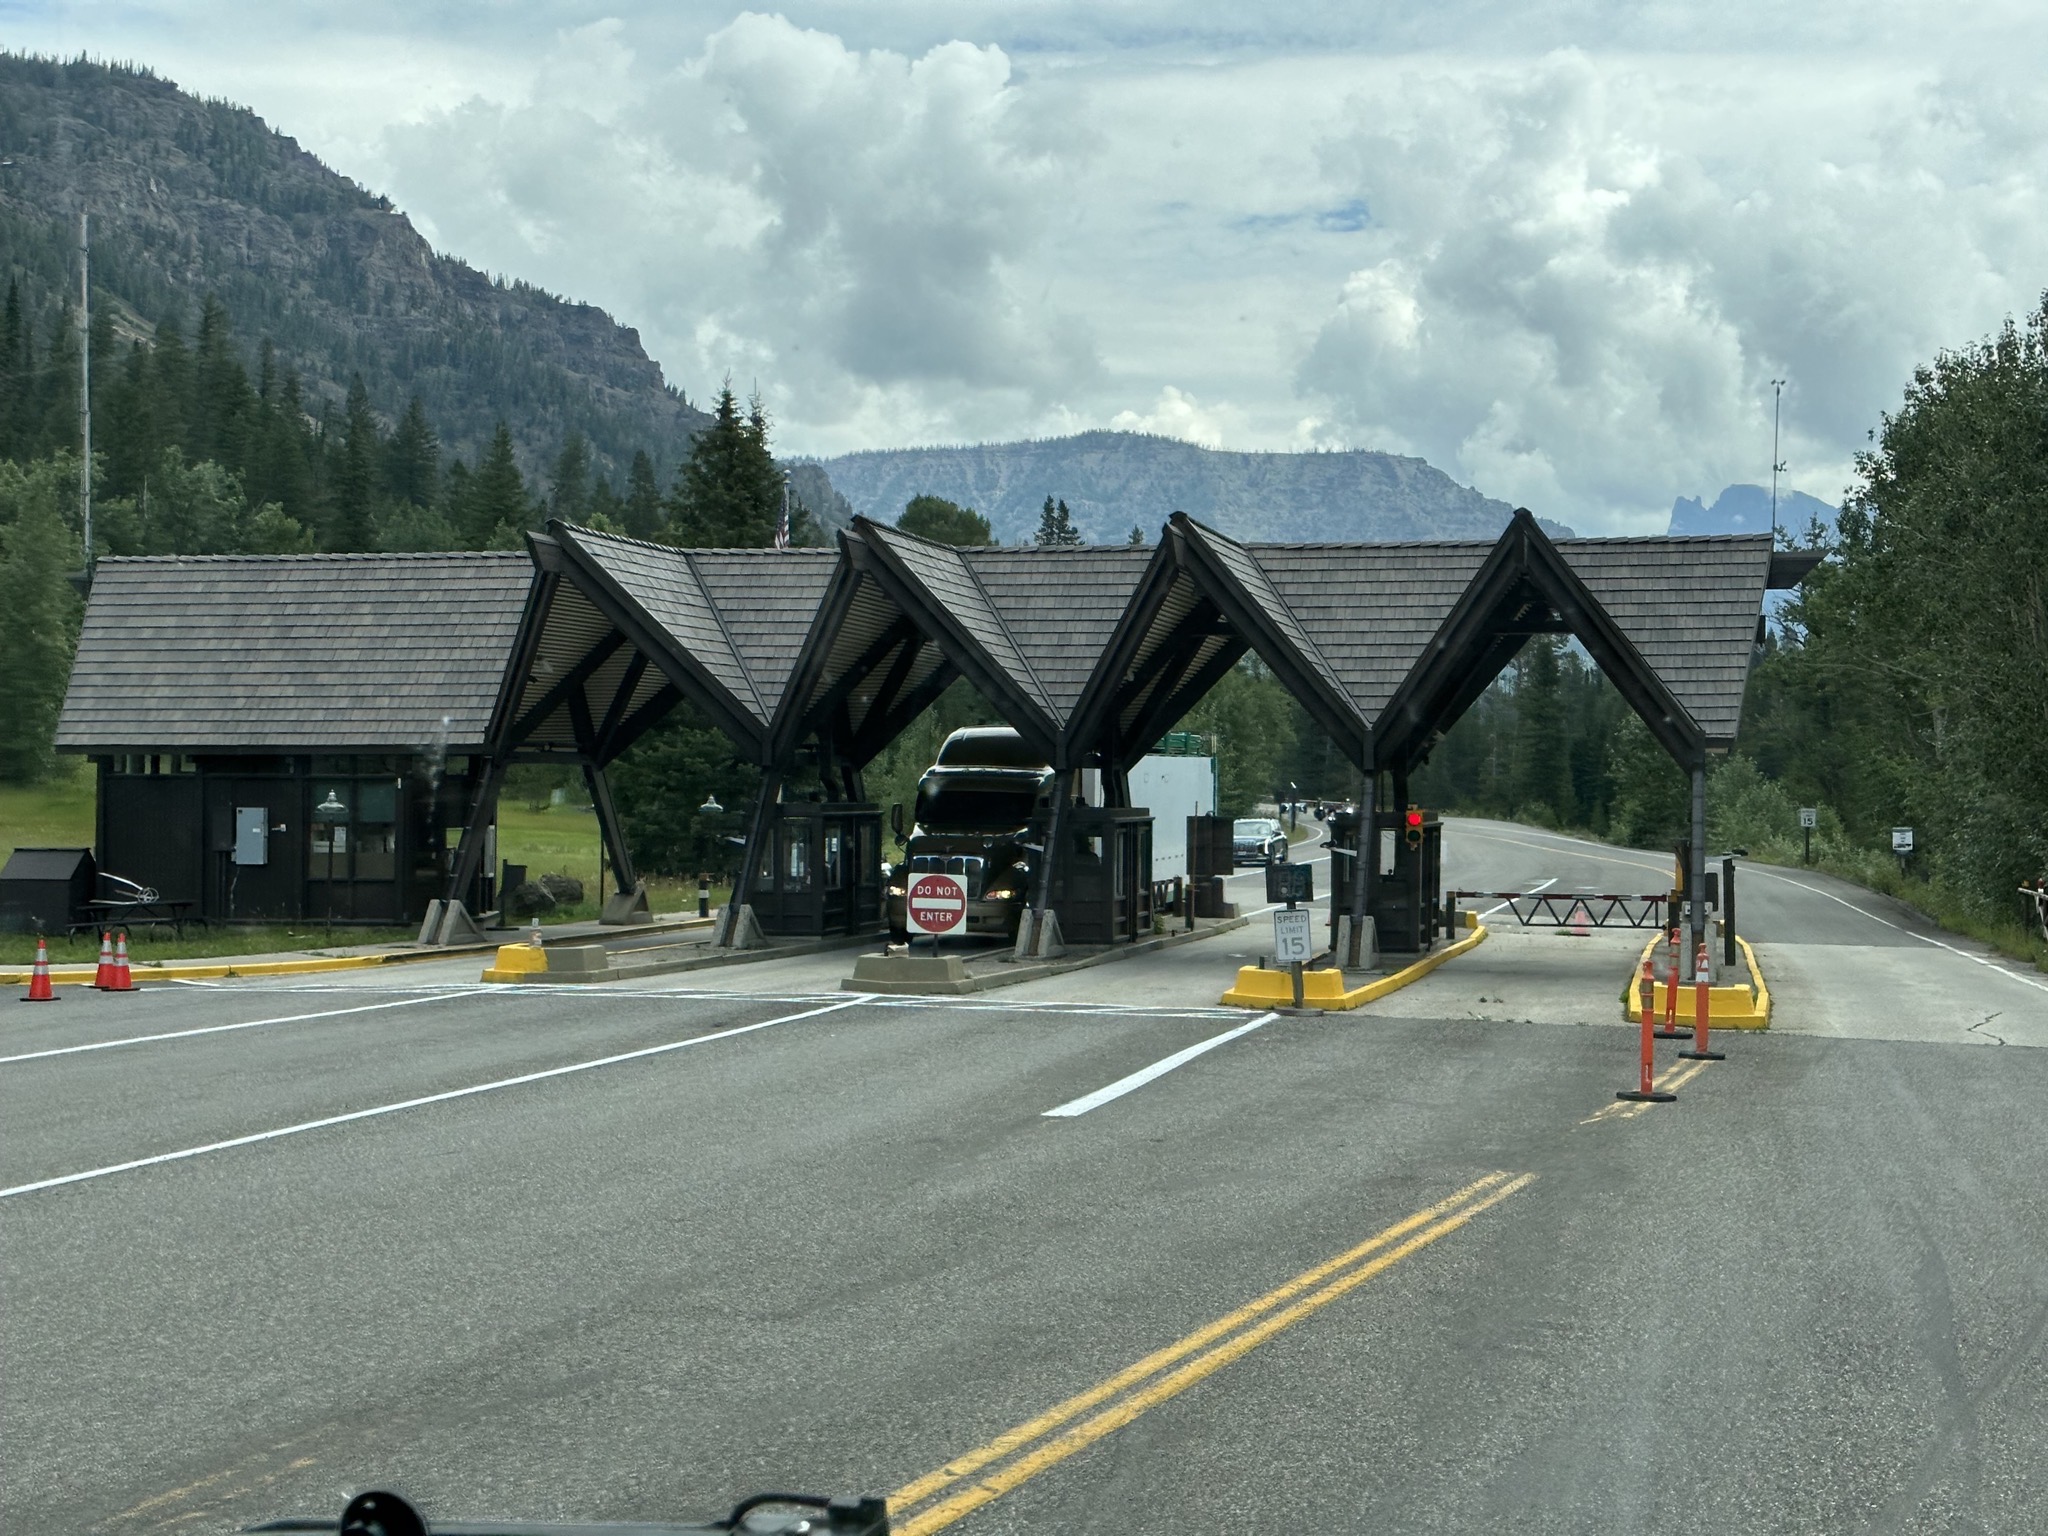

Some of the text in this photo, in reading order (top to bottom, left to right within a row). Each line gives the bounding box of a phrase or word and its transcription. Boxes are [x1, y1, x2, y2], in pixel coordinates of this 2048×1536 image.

[1803, 817, 1813, 825] 15
[917, 885, 957, 896] DO NOT
[920, 911, 952, 921] ENTER
[1277, 914, 1306, 924] SPEED
[1281, 925, 1303, 934] LIMIT
[1282, 937, 1304, 955] 15
